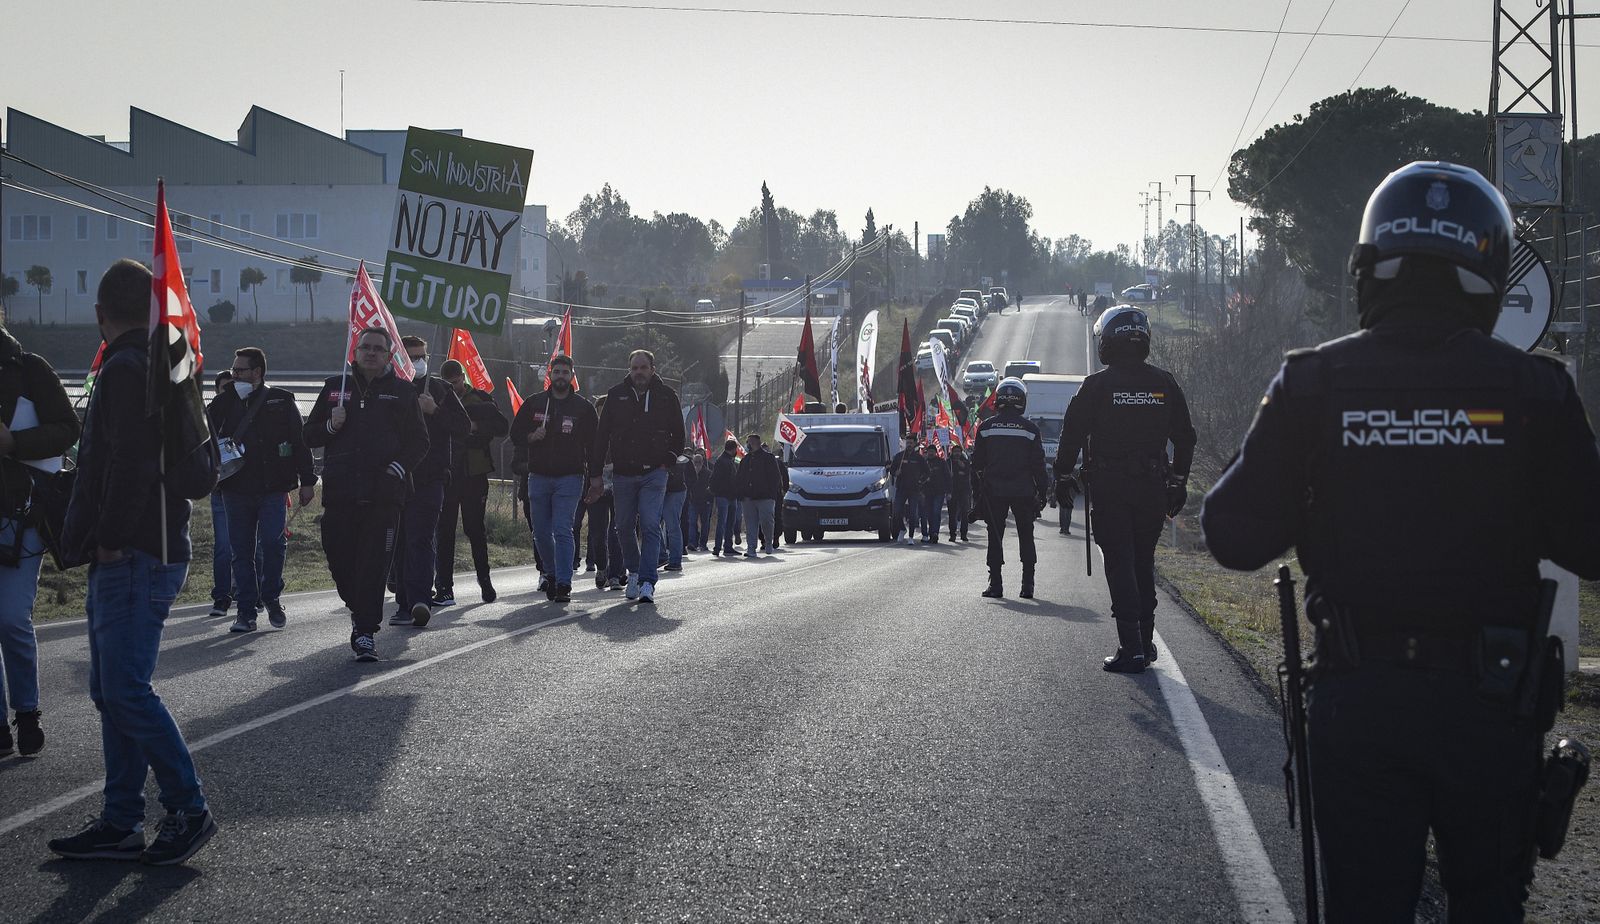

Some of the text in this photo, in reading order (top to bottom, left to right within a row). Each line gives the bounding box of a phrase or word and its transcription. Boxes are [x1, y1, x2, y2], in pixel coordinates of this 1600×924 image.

[394, 193, 521, 270] NO HAY
[1374, 217, 1478, 249] POLICIA
[387, 261, 502, 326] FUTURO
[1342, 409, 1472, 427] POLICIA
[1343, 428, 1504, 446] NACIONAL
